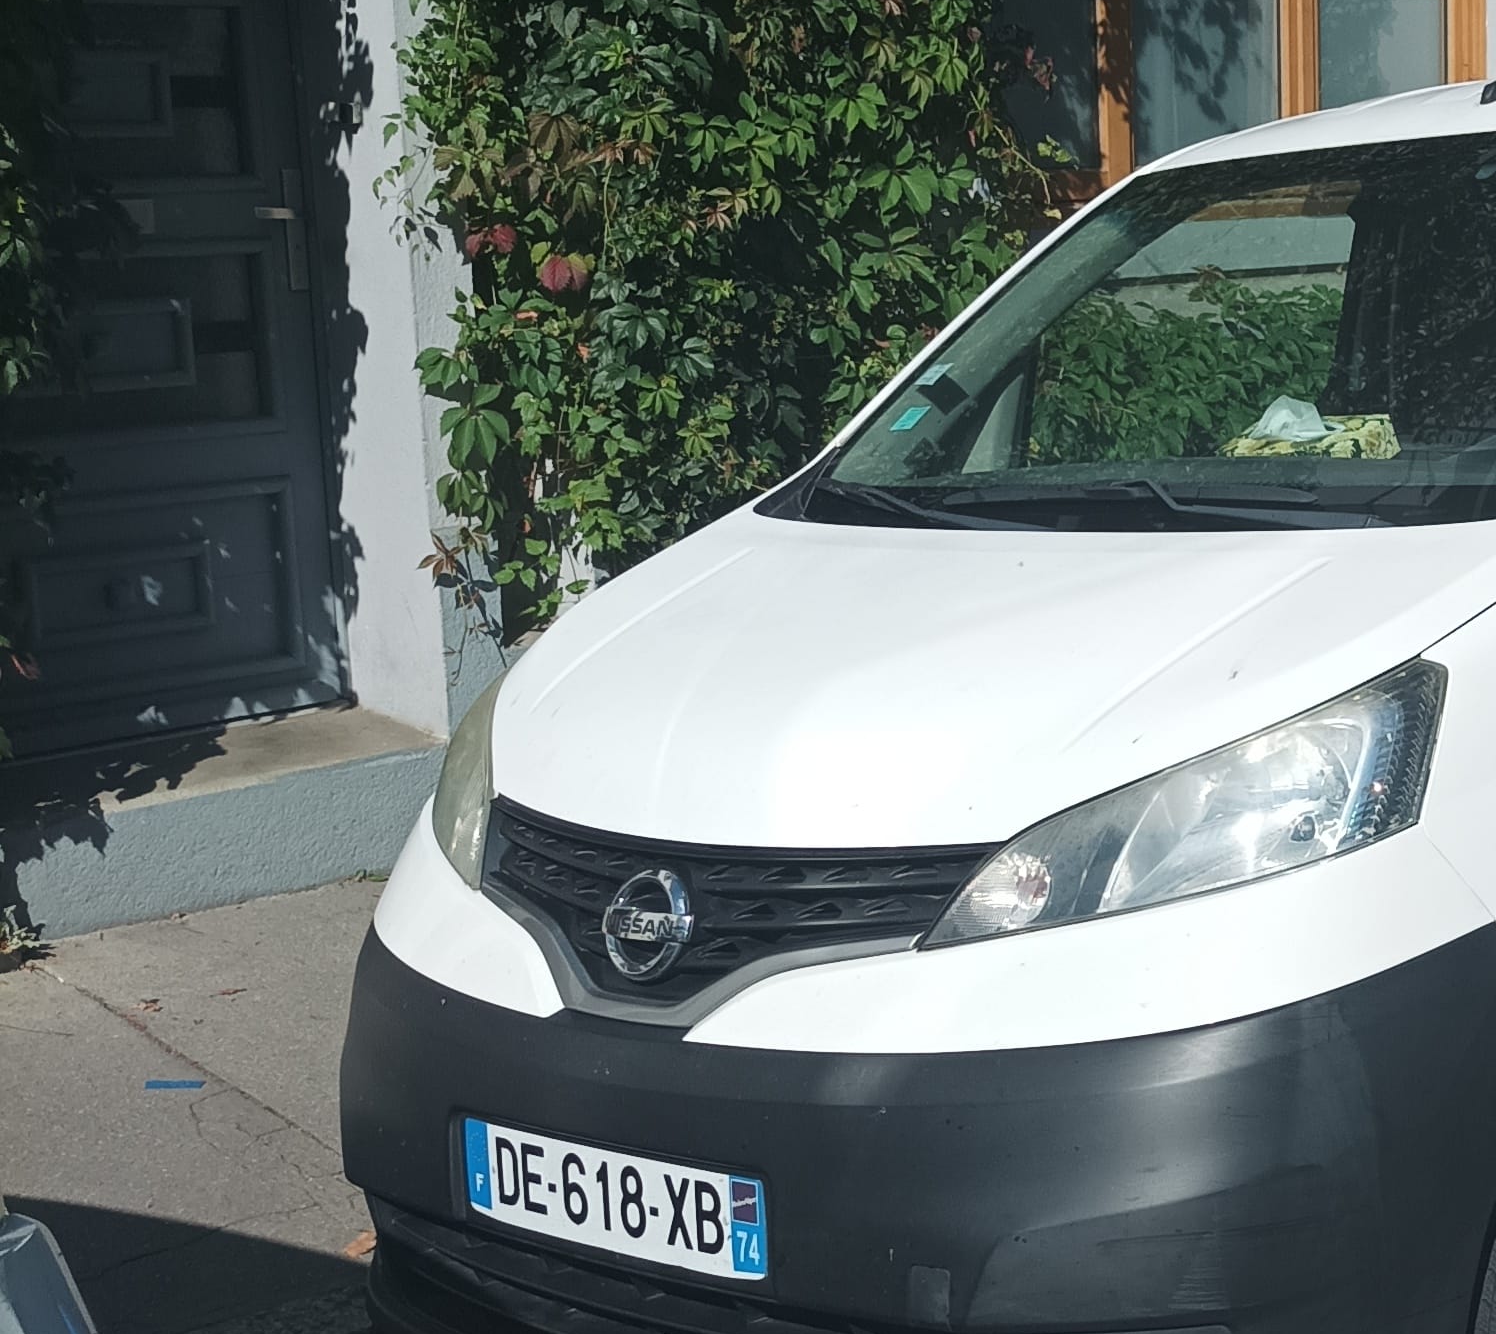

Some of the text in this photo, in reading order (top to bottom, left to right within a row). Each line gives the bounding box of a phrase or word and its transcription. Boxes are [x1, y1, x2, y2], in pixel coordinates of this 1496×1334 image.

[475, 1173, 485, 1192] F
[495, 1136, 725, 1255] DE-618-XB
[736, 1231, 760, 1266] 74
